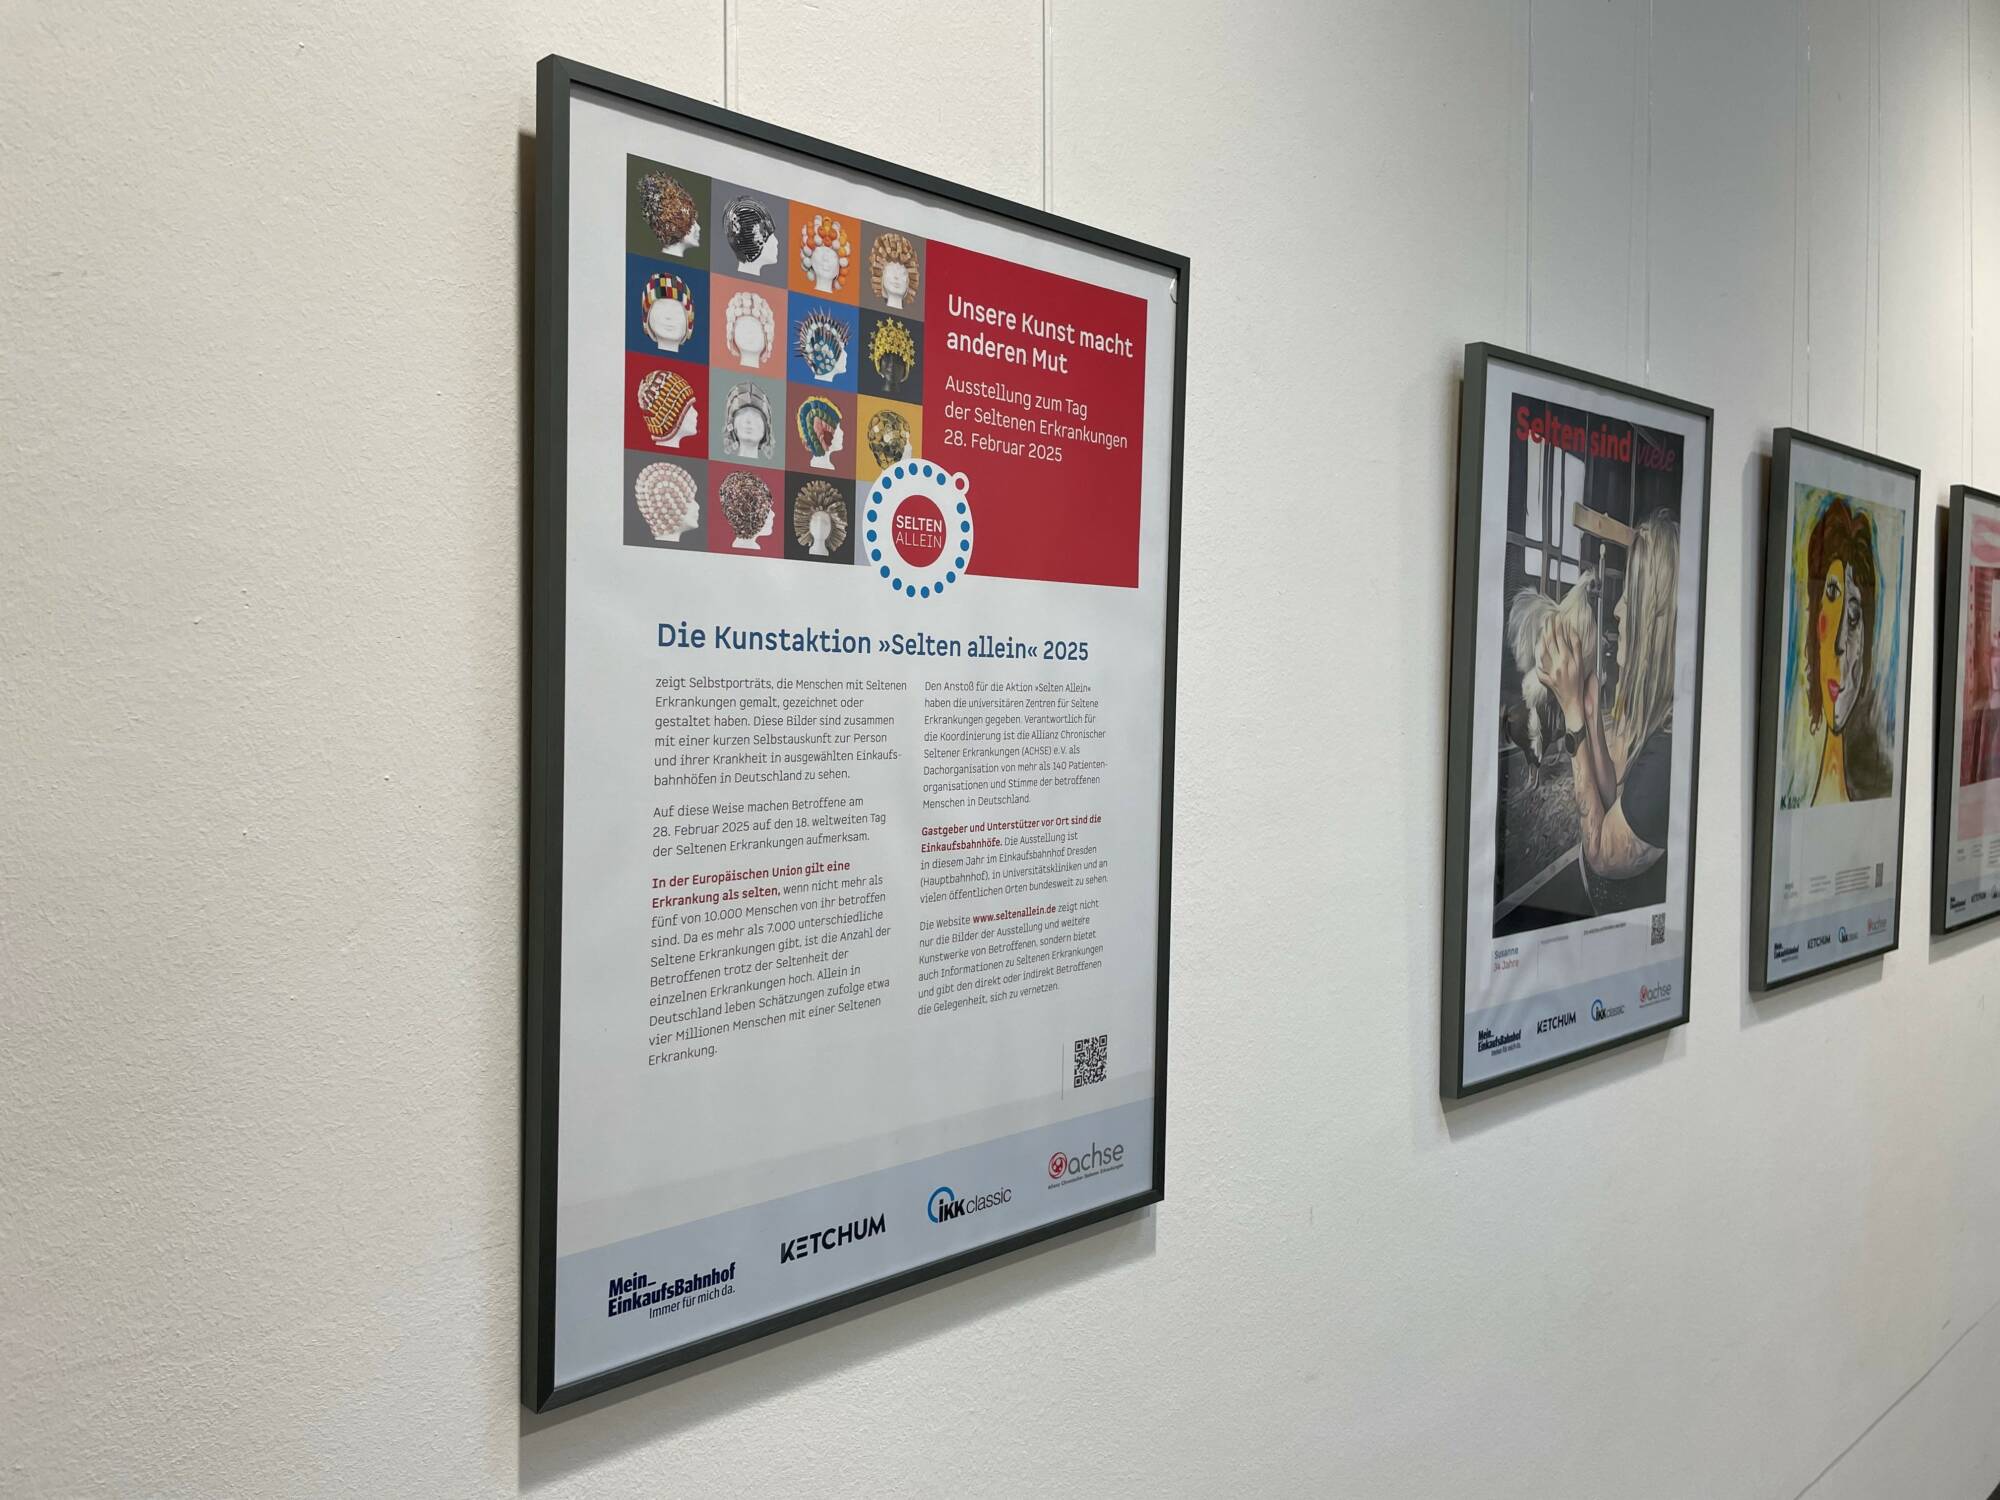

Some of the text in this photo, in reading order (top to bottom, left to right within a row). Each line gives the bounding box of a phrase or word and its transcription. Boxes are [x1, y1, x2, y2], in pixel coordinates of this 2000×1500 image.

[948, 294, 1133, 357] Unsere Kunst macht
[946, 332, 1068, 374] anderen Mut
[945, 375, 1087, 420] Ausstellung zum Tag
[944, 400, 1127, 450] der Seltenen Erkrankungen
[1516, 406, 1585, 452] Selten
[1590, 424, 1631, 463] sind
[944, 428, 1062, 462] 28. Februar 2025
[896, 514, 943, 532] SELTEN
[896, 531, 943, 549] ALLEIN
[658, 621, 705, 648] Die
[715, 625, 870, 654] Kunstaktion
[1043, 640, 1088, 661] 2025
[655, 676, 907, 691] zeigt Selbstporträts, die Menschen mit Seltenen
[655, 695, 864, 711] Erkrankungen gemalt, gezeichnet oder
[654, 714, 894, 730] gestaltet haben. Diese Bilder sind zusammen
[654, 732, 887, 747] mit einer kurzen Selbstauskunft zur Person
[654, 754, 677, 767] und
[679, 754, 710, 766] ihrer
[712, 752, 767, 764] Krankheit
[770, 751, 781, 763] in
[783, 750, 853, 765] ausgewählten
[923, 762, 999, 777] Dachorganisation
[1000, 763, 1016, 772] von
[1017, 761, 1037, 771] mehr
[1038, 760, 1051, 771] als
[1052, 760, 1067, 771] 140
[654, 768, 850, 786] bahnhöfen in Deutschland zu sehen.
[922, 774, 1100, 794] organisationen und Stimme der betroffenen
[652, 796, 863, 818] Auf diese Weise machen Betroffene am
[652, 813, 886, 838] 28. Februar 2025 auf den 18. weltweiten Tag
[921, 813, 1101, 837] Gastgeber und Unterstützer vor Ort sind die
[652, 831, 869, 858] der Seltenen Erkrankungen aufmerksam.
[921, 831, 1078, 853] Einkaufsbahnhöfe. Die Ausstellung ist
[920, 844, 1097, 870] in diesem Jahr im Einkaufsbahnhof Dresden
[652, 860, 850, 888] In der Europäischen Union gilt eine
[651, 874, 883, 908] Erkrankung als selten, wenn nicht mehr als
[919, 899, 1099, 931] Die Website www.seltenallein.de zeigt nicht
[918, 944, 1103, 981] auch Informationen zu Seltenen Erkrankungen
[1537, 1011, 1577, 1034] KETCHUM
[1069, 1142, 1124, 1175] achse
[966, 1187, 1011, 1214] classic
[780, 1213, 886, 1264] KETCHUM
[608, 1262, 736, 1317] EinkaufsBahnhof
[649, 1284, 735, 1319] Immer für mich da.
